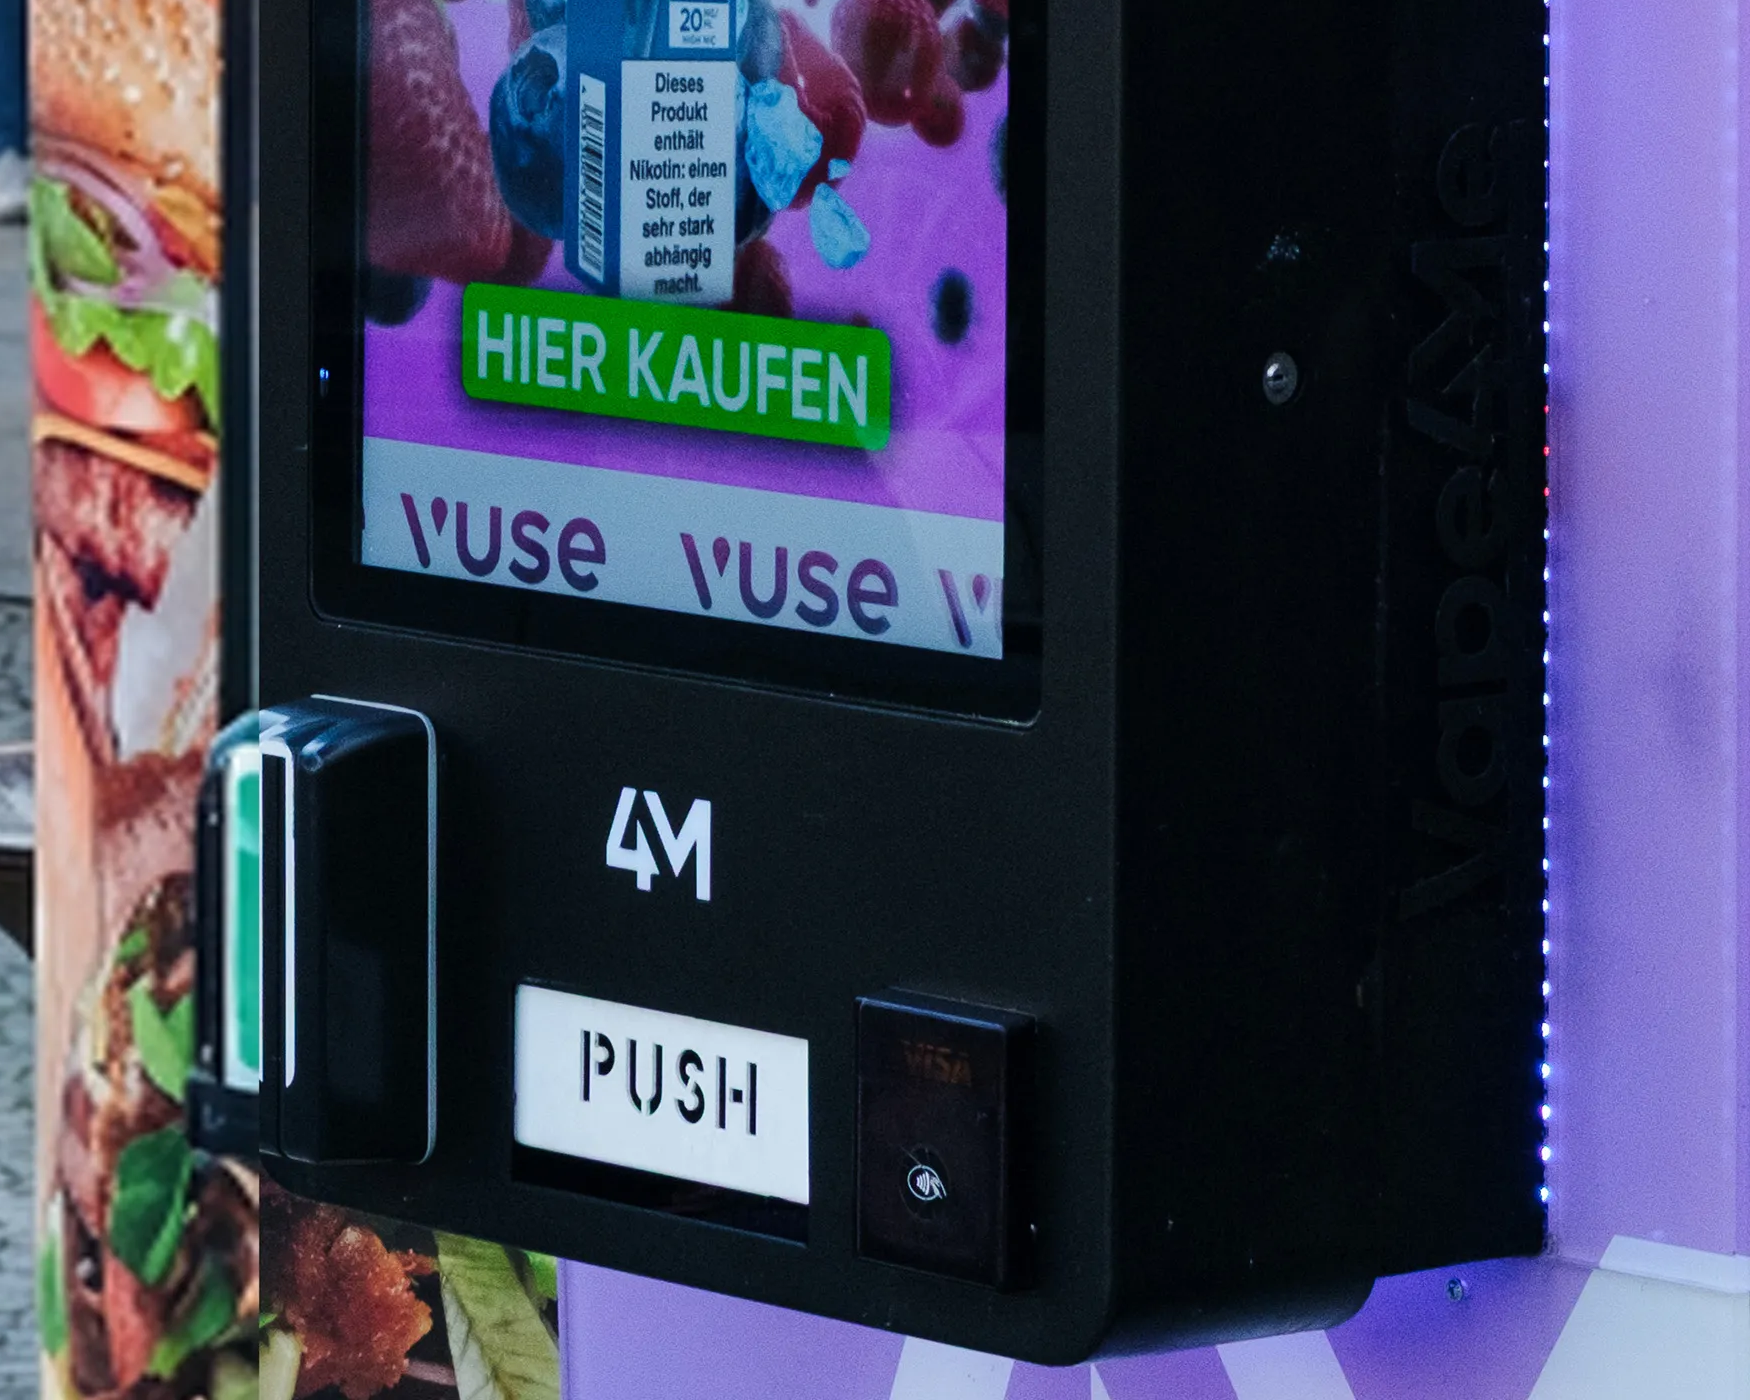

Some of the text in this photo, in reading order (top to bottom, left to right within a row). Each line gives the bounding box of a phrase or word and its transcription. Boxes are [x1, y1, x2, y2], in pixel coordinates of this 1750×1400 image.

[680, 8, 703, 33] 20
[655, 72, 704, 94] Dieses
[651, 101, 708, 122] Produkt
[654, 129, 704, 151] enthält
[630, 157, 727, 181] Nikotin: einen
[646, 186, 712, 212] Stoff, der
[642, 214, 715, 238] sehr stark
[644, 242, 712, 270] abhängig
[654, 272, 703, 295] macht.
[476, 309, 869, 428] HIER KAUFEN
[606, 786, 712, 902] 4M
[579, 1029, 758, 1137] PUSH
